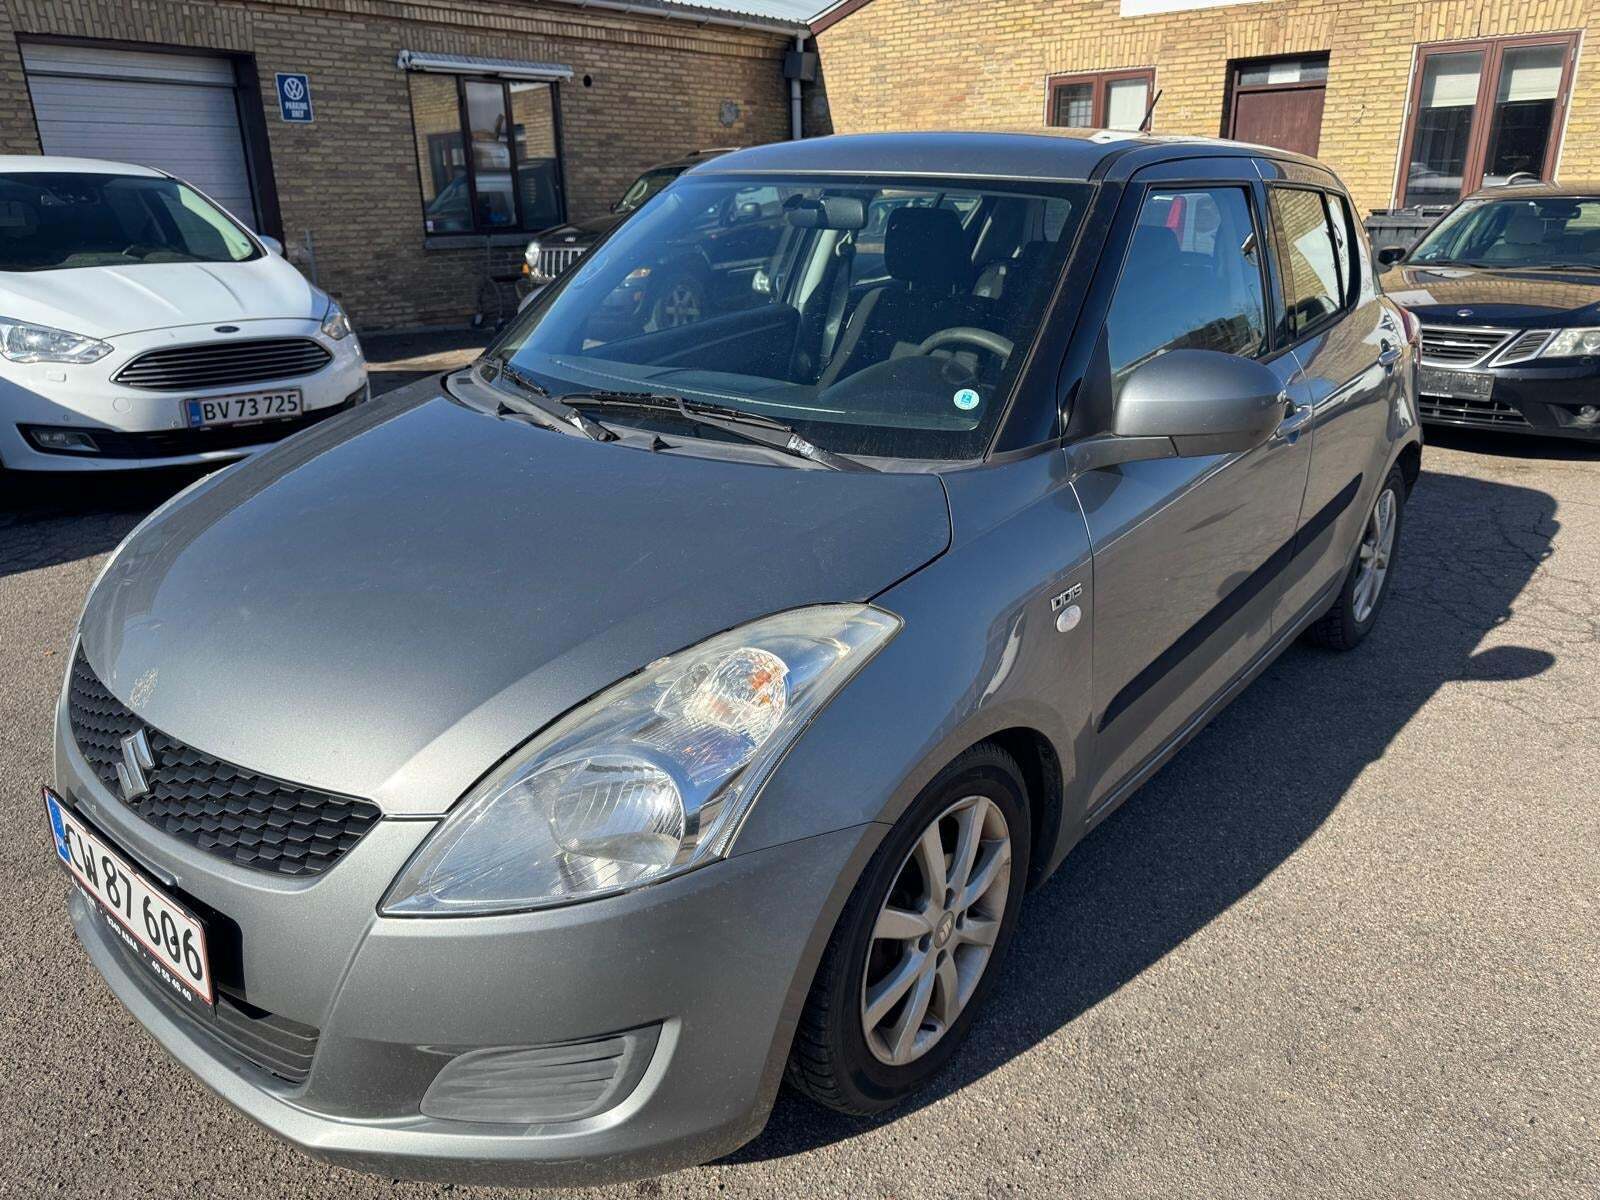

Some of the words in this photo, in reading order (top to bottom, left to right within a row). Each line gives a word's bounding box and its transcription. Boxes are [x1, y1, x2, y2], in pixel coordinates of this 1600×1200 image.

[203, 402, 229, 421] BV
[235, 399, 259, 417] 73
[263, 394, 298, 415] 725
[65, 823, 100, 890] CW
[102, 855, 132, 920] 87
[142, 895, 203, 981] 606
